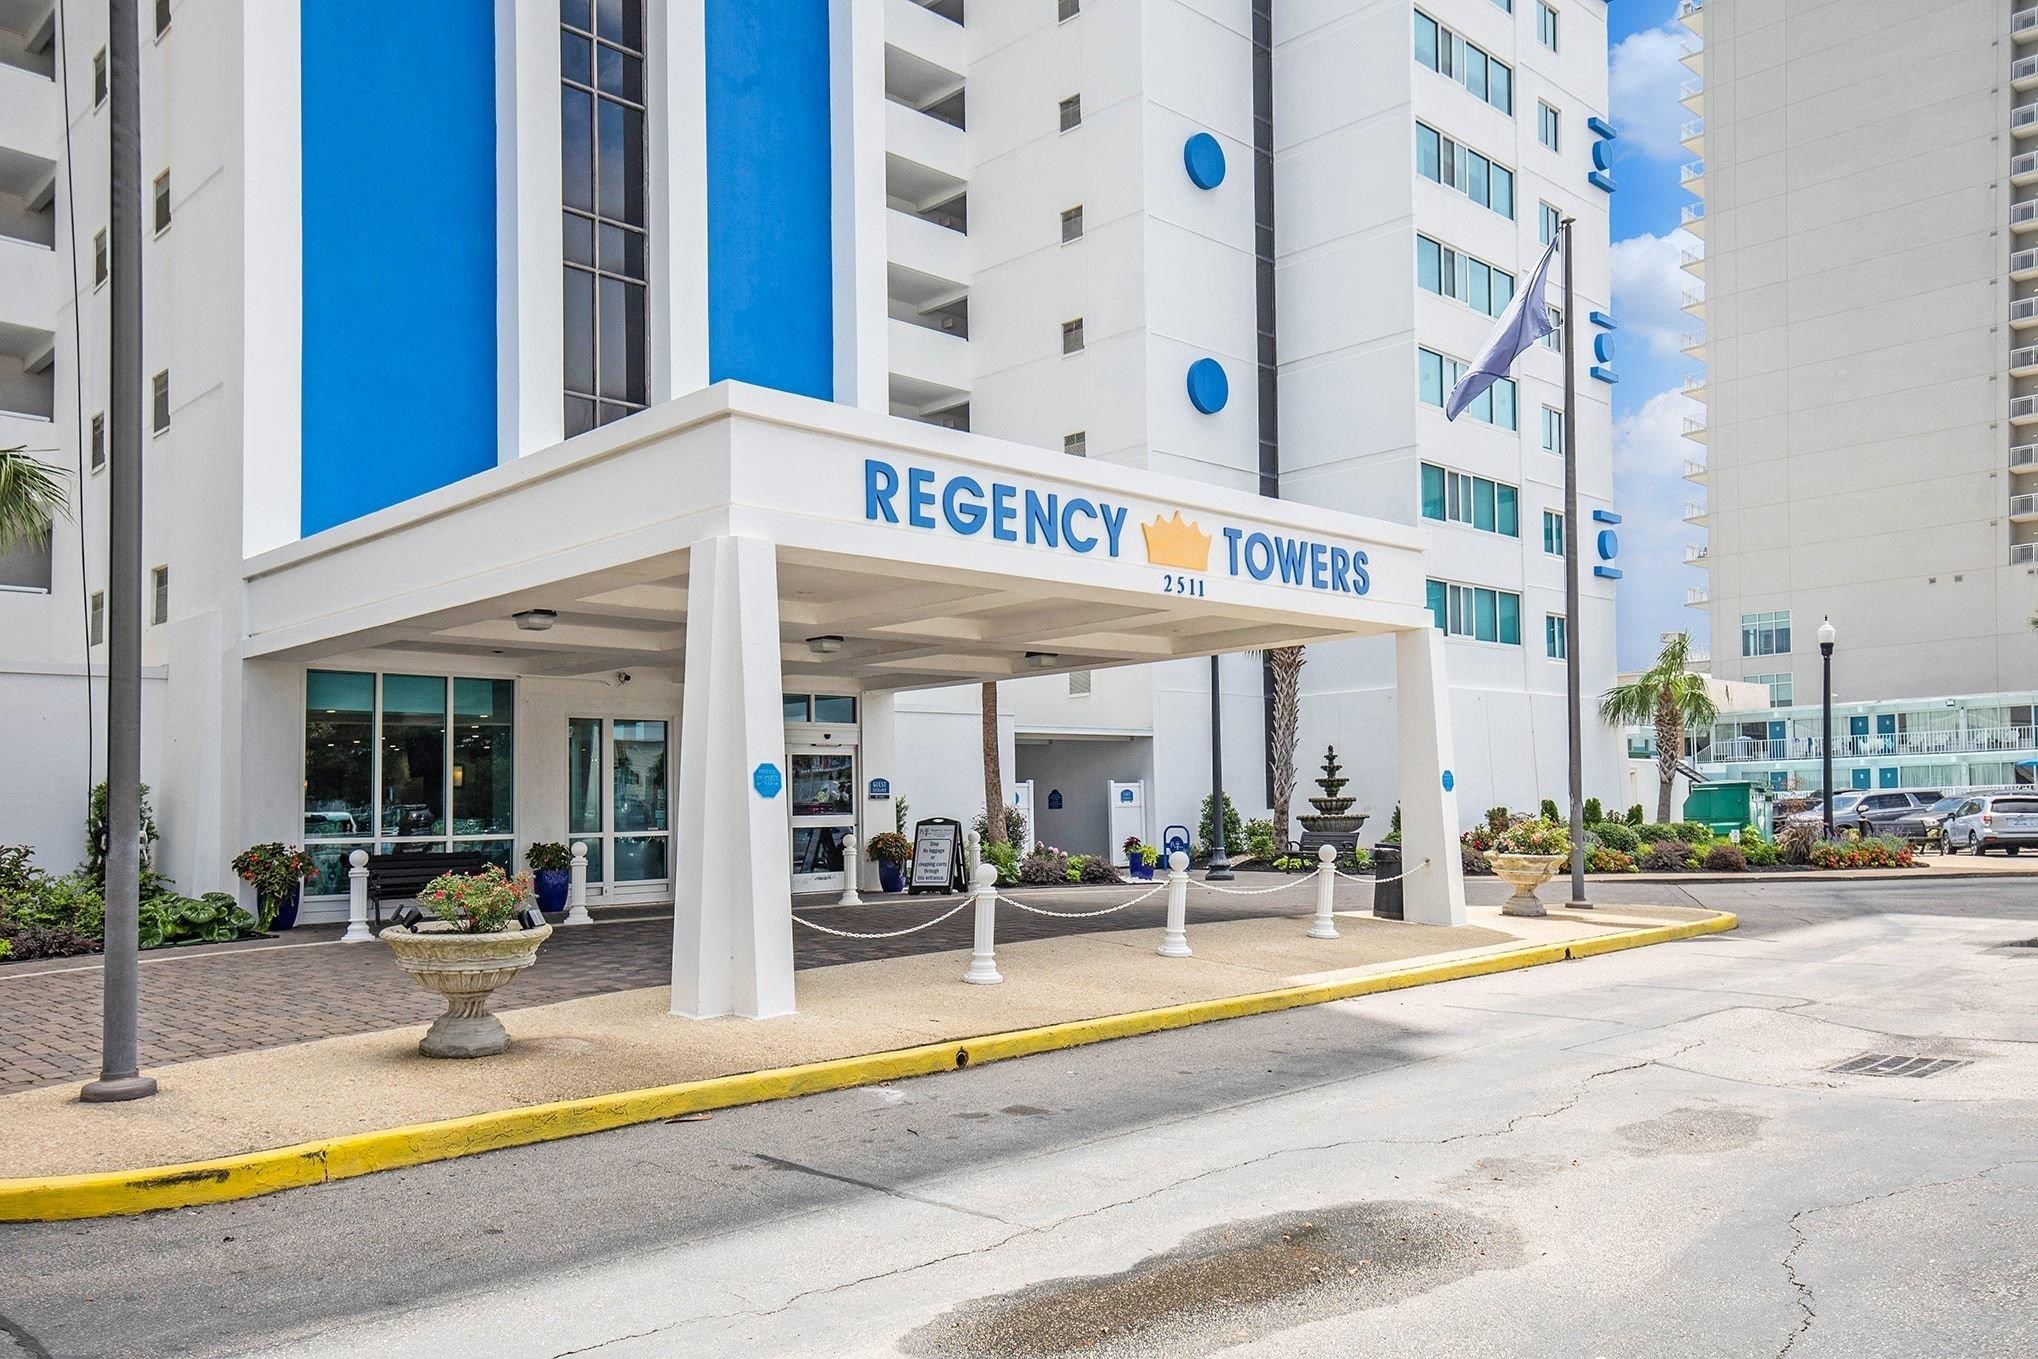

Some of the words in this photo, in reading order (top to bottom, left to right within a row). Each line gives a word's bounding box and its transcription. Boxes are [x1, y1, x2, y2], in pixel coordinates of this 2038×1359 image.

[865, 459, 1128, 558] REGENCY
[1223, 527, 1370, 596] TOWERS
[1164, 574, 1204, 597] 2511
